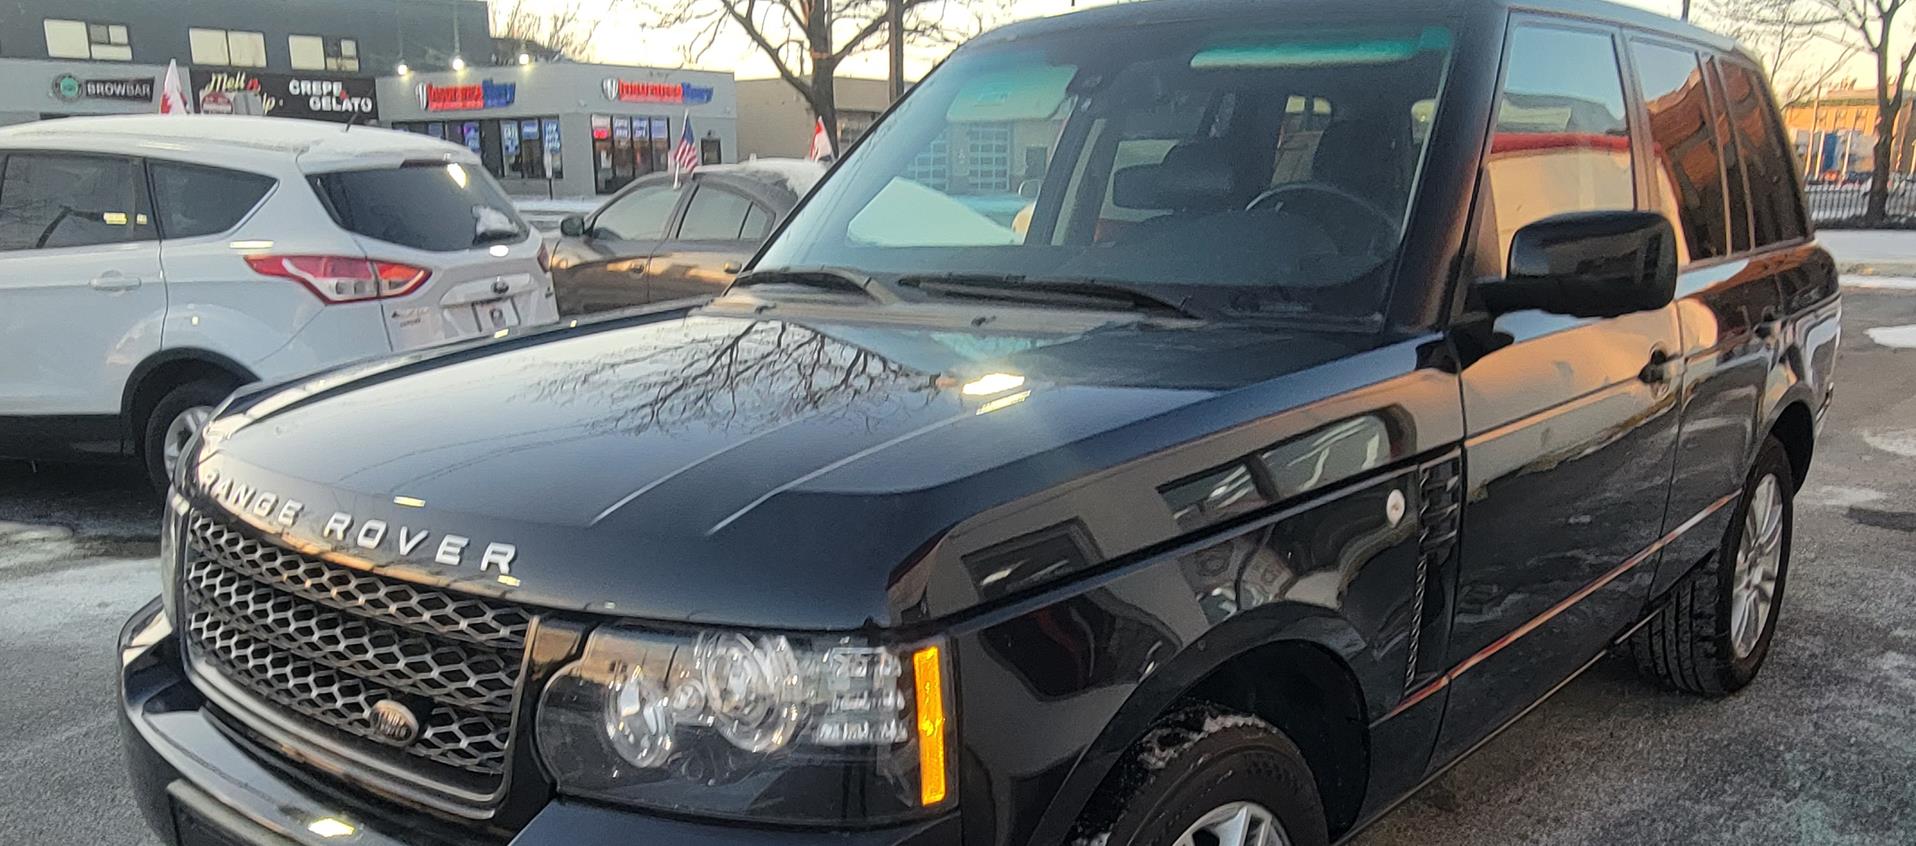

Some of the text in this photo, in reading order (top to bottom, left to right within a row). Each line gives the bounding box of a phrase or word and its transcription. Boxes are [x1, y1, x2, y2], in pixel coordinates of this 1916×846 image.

[289, 79, 342, 97] CREPE
[309, 96, 372, 113] GELATO
[200, 470, 516, 575] RANGE ROVER
